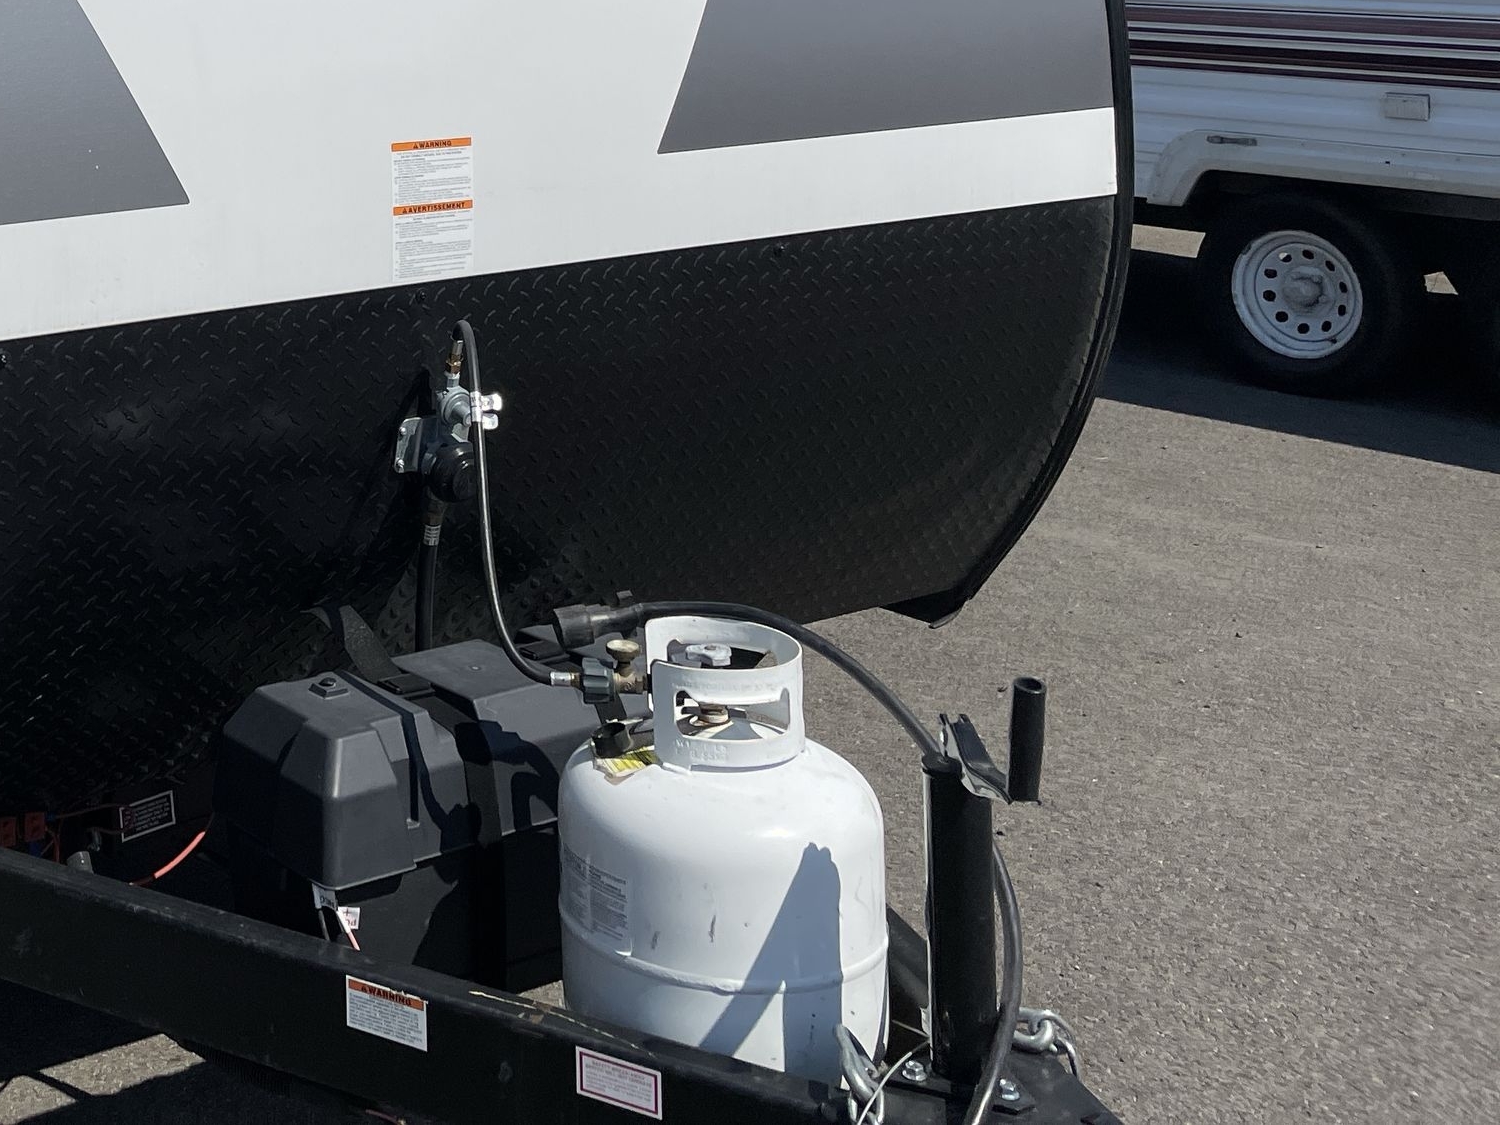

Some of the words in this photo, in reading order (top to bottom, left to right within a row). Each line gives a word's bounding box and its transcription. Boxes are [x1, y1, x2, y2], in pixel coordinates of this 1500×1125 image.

[419, 140, 452, 149] WARNING
[408, 202, 465, 214] AVERTISSEMENT
[368, 986, 412, 1006] WARNING
